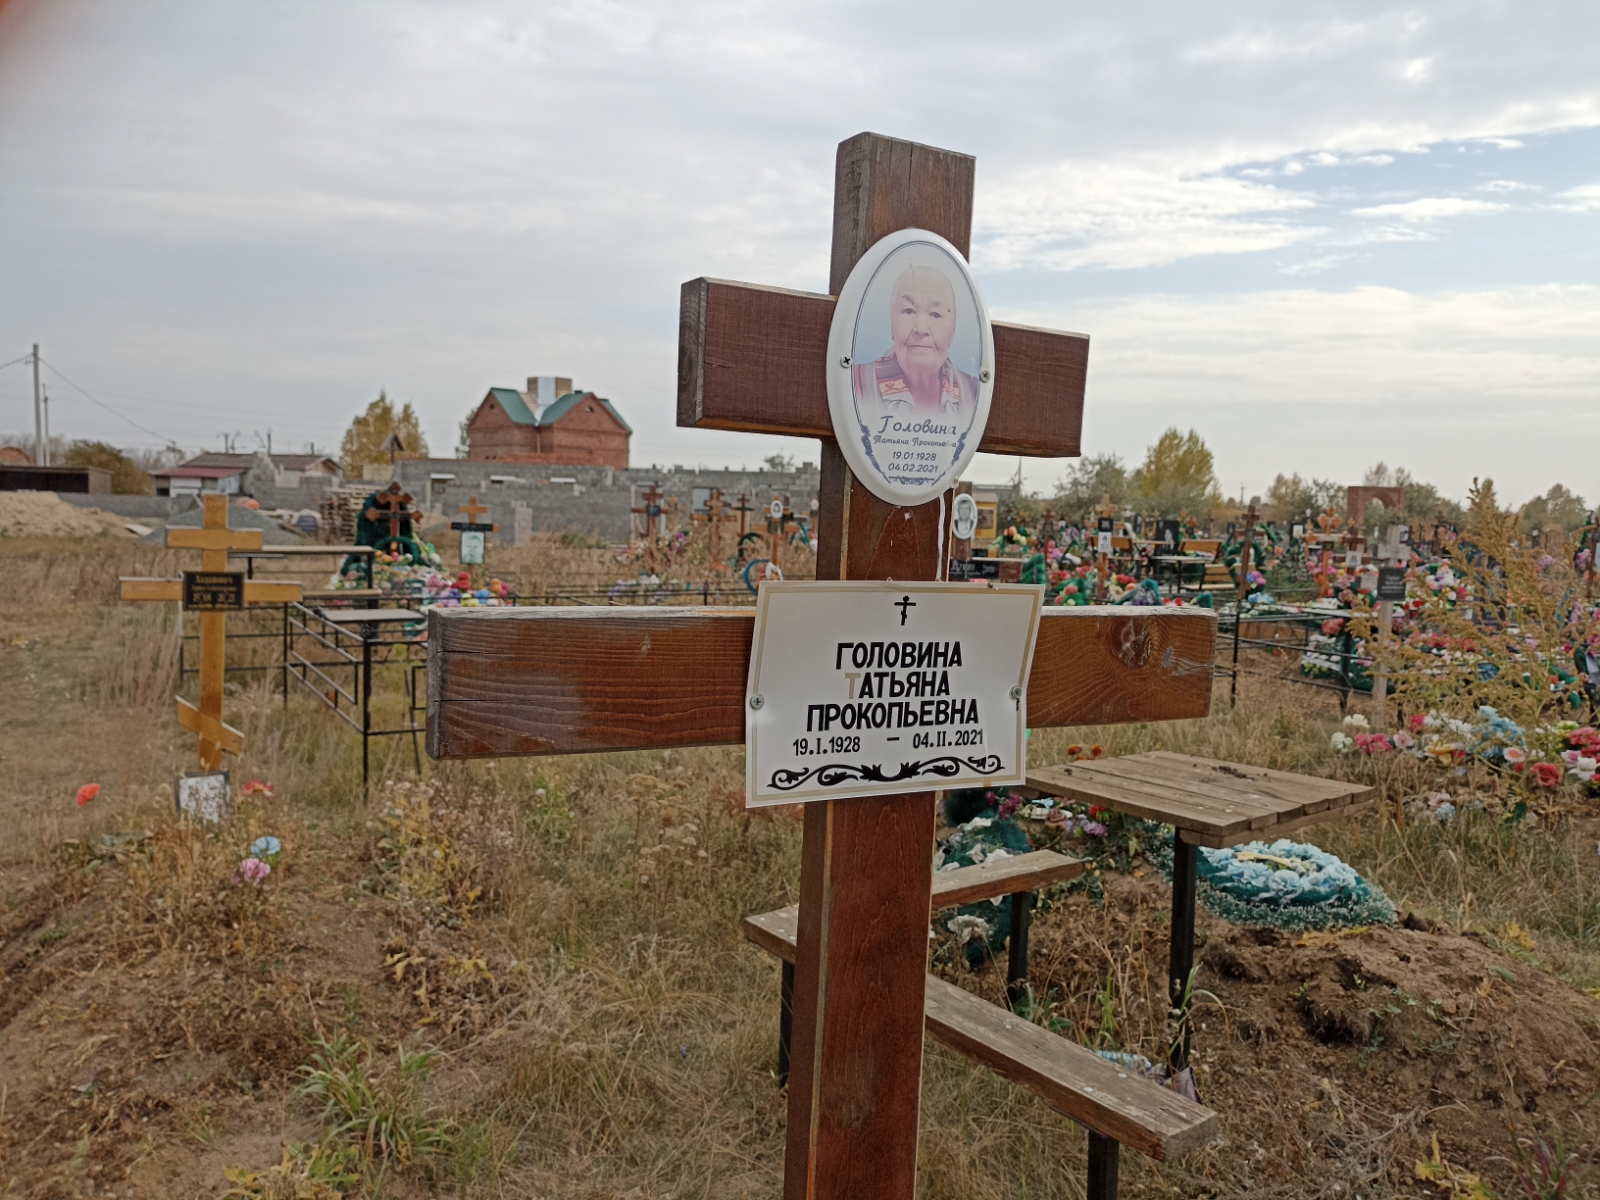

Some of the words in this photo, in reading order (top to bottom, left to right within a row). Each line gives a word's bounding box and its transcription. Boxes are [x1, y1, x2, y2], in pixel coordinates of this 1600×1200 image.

[877, 415, 957, 435] Головина
[873, 435, 909, 445] Татьяна
[912, 437, 957, 448] Прокопьеа
[892, 451, 937, 461] 19.01.1928
[887, 462, 938, 473] 04.02.2021
[836, 641, 962, 669] ГОЛОВИНА
[844, 670, 950, 699] ТАТЬЯНА
[806, 699, 979, 732] ПРОКОПЬЕВНА
